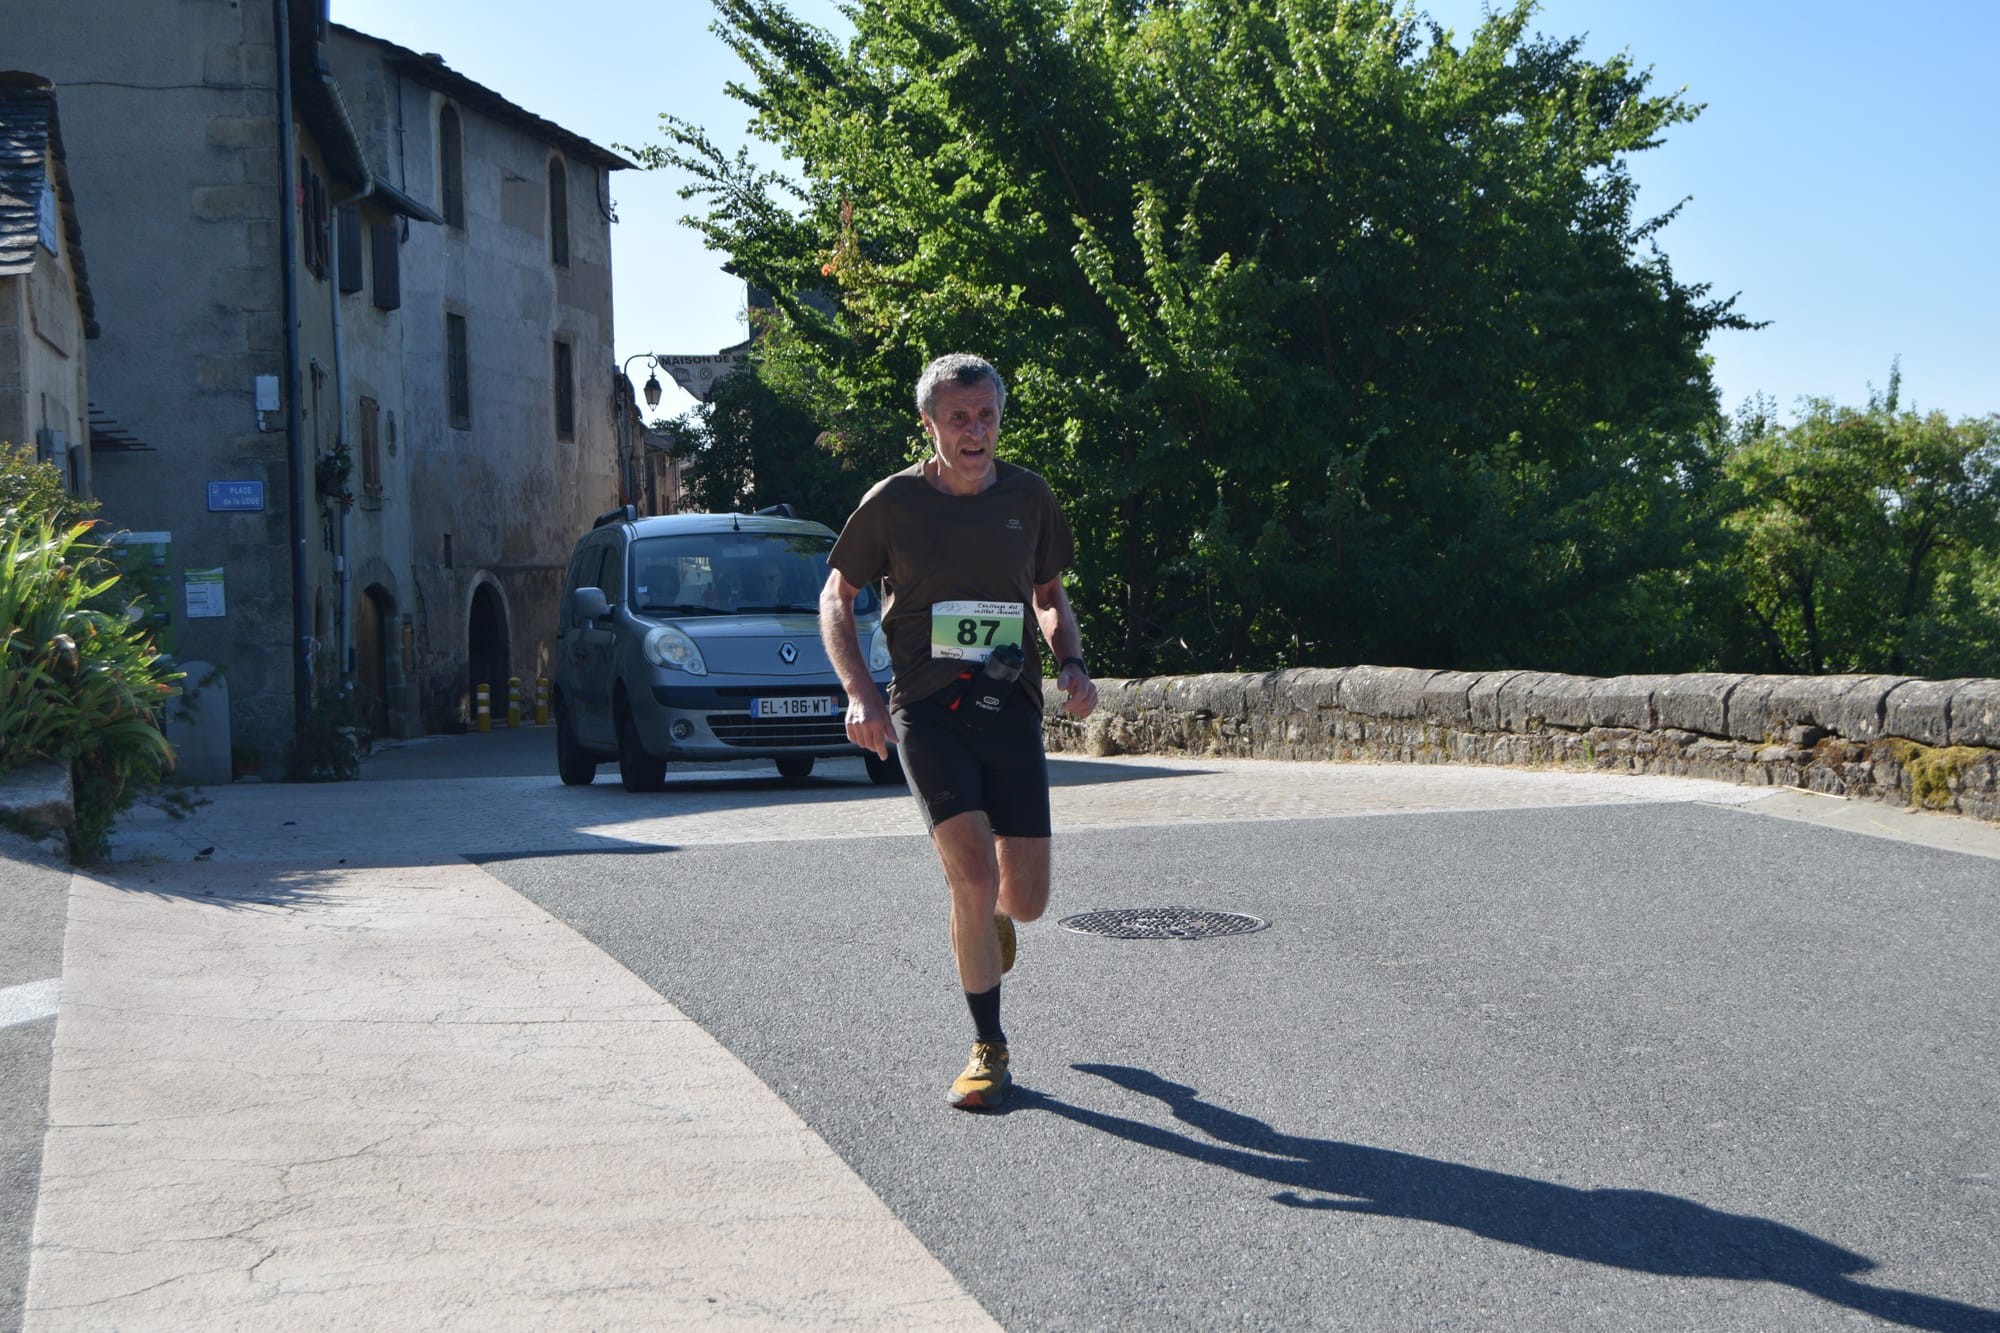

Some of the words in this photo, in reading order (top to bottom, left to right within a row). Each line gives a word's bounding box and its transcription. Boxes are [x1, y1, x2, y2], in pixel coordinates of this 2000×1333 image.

[660, 356, 711, 365] MAISON
[714, 355, 730, 363] DE
[229, 486, 252, 495] PLACE
[957, 619, 1000, 646] 87
